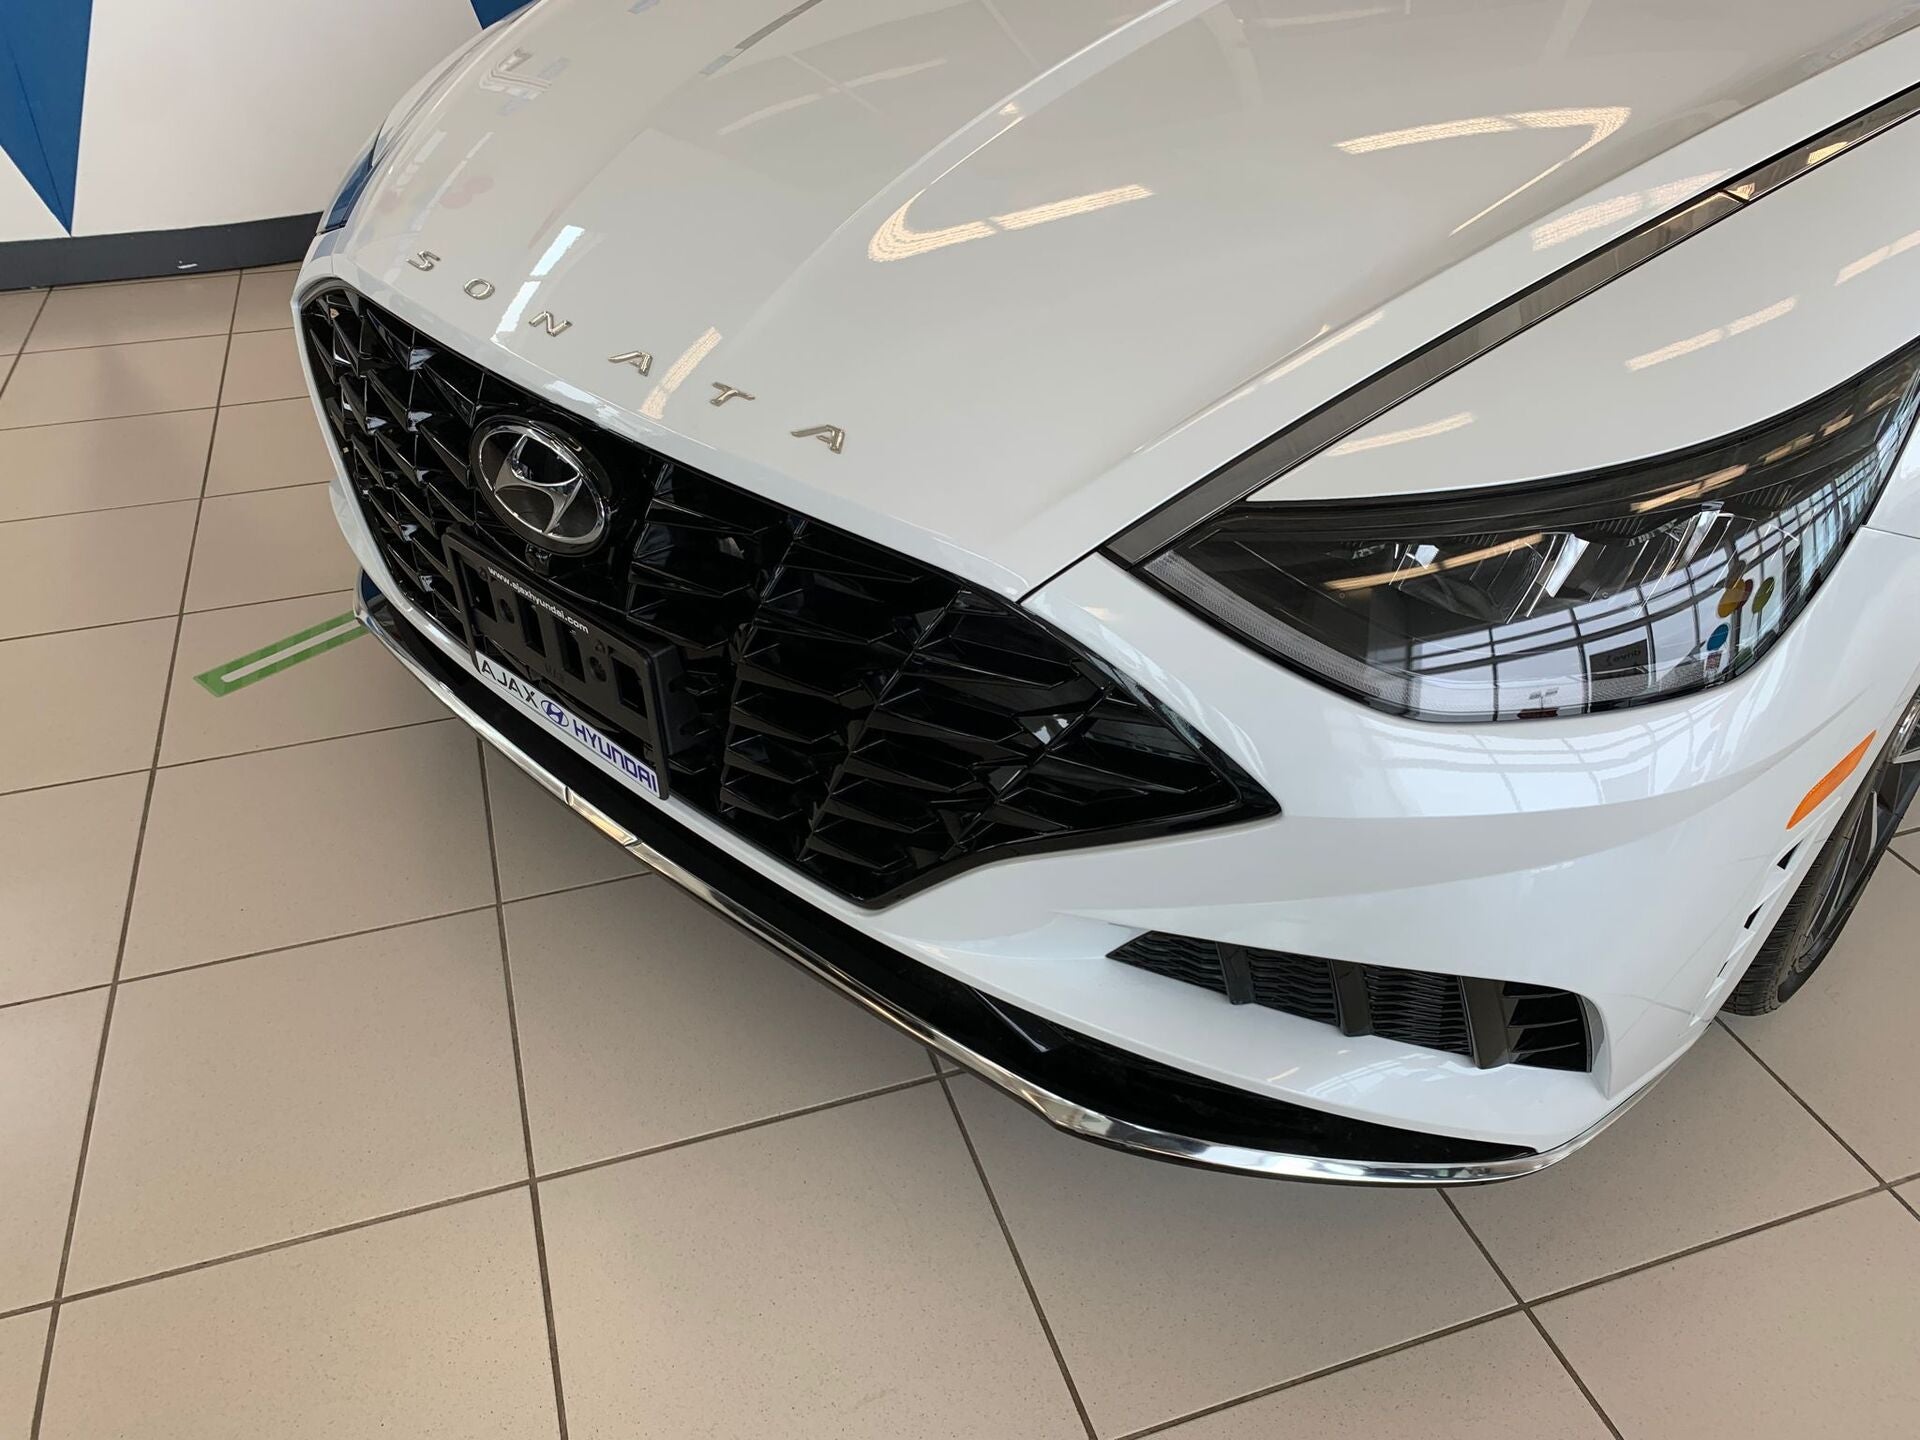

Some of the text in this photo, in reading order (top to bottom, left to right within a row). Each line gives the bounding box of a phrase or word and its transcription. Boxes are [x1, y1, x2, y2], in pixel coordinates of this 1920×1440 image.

[406, 249, 845, 454] SONATA
[487, 566, 589, 634] www.ajaxhyundai.com
[481, 659, 658, 793] AJAX HYUNDAI
